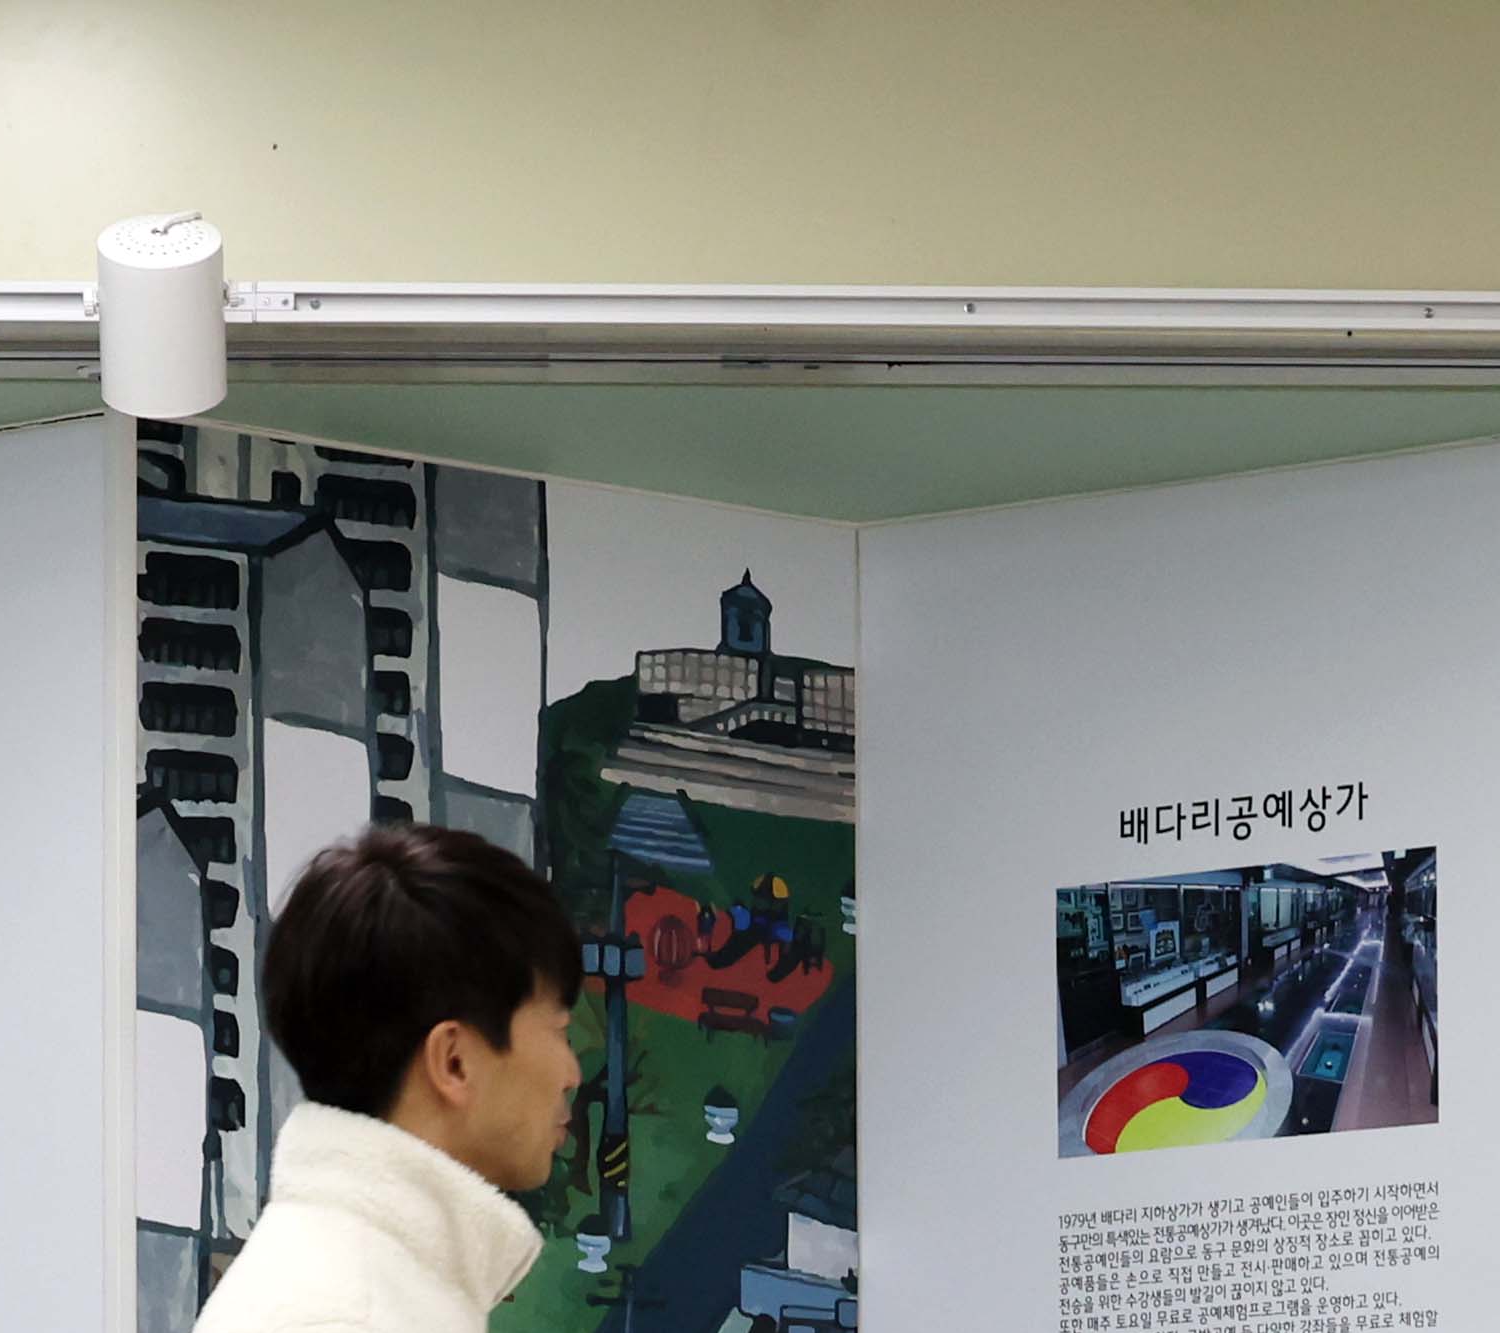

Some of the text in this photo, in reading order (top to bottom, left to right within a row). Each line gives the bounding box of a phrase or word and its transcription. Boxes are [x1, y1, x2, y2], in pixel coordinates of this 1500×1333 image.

[1119, 781, 1369, 845] 배다리공예상가
[1058, 1180, 1439, 1230] 1979년 배다리 지하상가가 생기고 공예인들이 입주하기 시작하면서
[1058, 1224, 1431, 1271] 전통공예인들의 요람으로 동구 문화의 상징적 장소로 꼽히고 있다.
